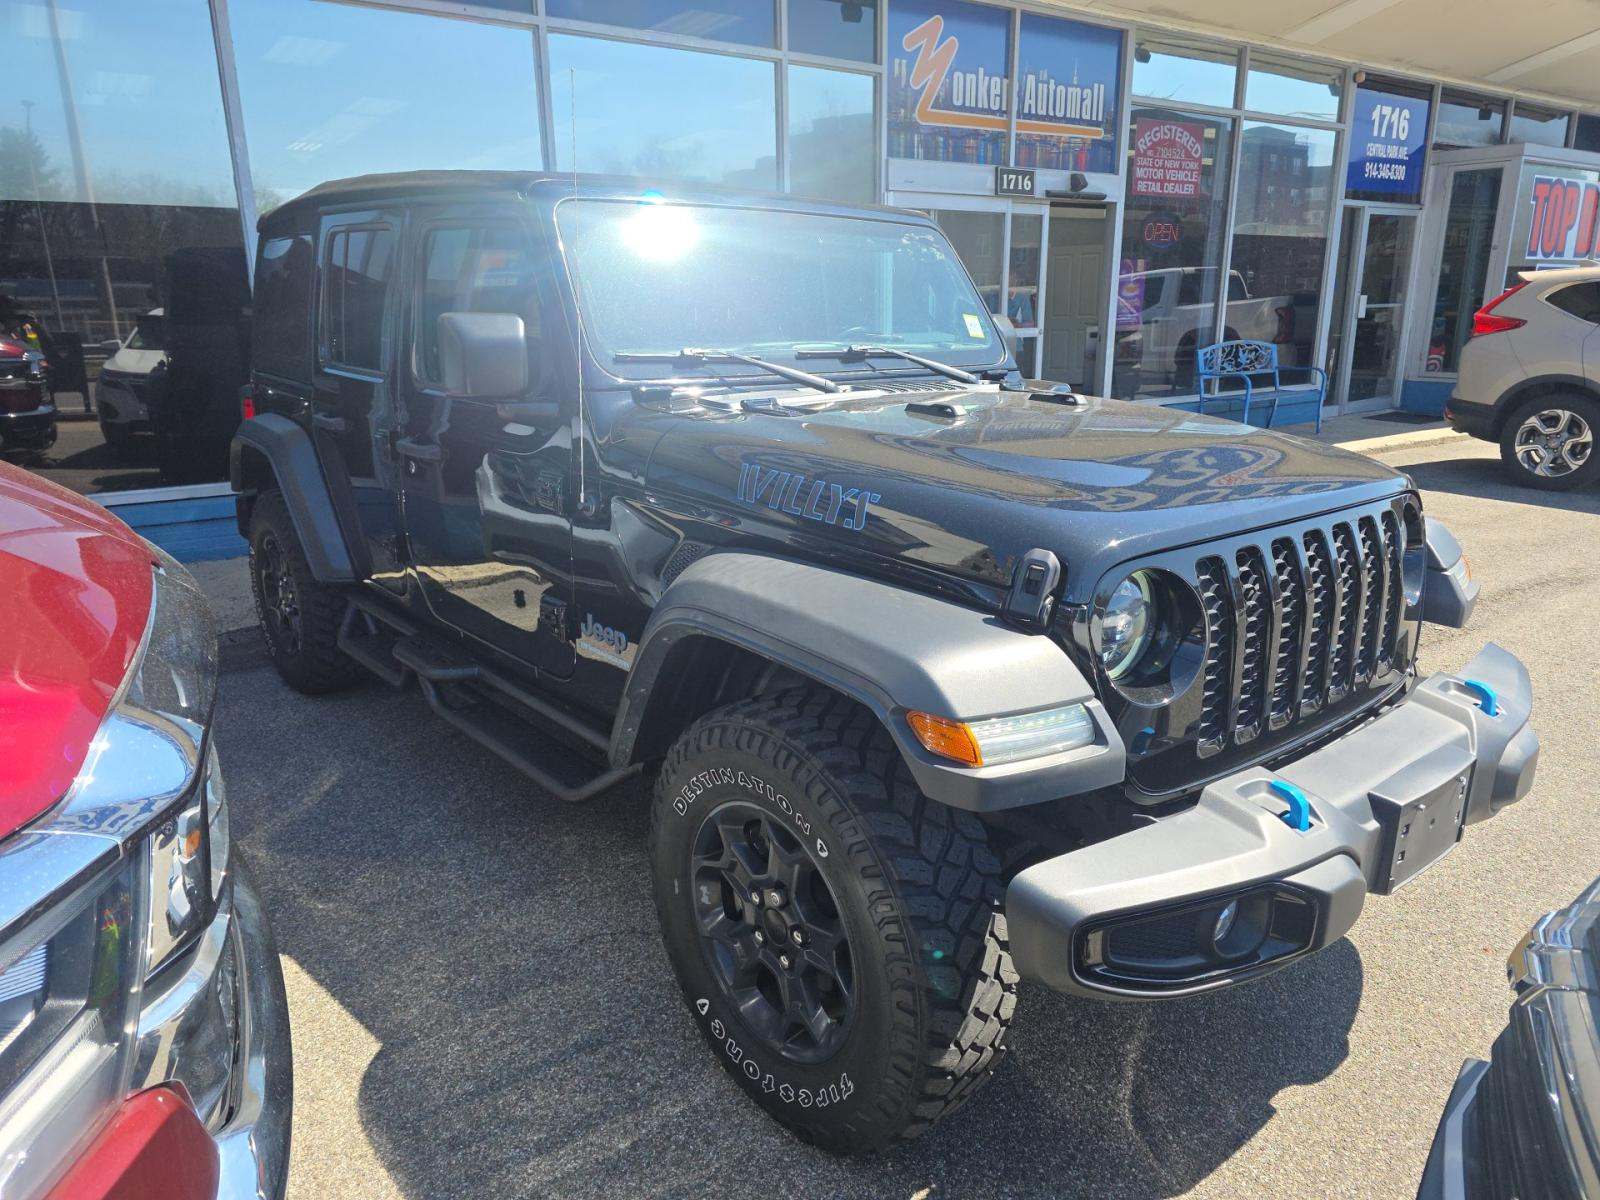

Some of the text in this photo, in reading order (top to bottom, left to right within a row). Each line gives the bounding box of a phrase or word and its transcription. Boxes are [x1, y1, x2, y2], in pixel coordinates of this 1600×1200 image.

[1023, 73, 1105, 122] Automall
[1371, 104, 1410, 141] 1716
[1137, 124, 1201, 158] REGISTERED
[1365, 143, 1387, 158] CENTRAL
[1387, 144, 1399, 159] PARK
[1136, 157, 1201, 170] STATE OF NEW YORK
[1136, 167, 1199, 182] MOTOR VEHICLE
[1002, 173, 1032, 191] 1716
[1136, 181, 1195, 195] RETAIL DEALER
[1144, 223, 1180, 241] OPEN
[1526, 176, 1580, 259] TOP
[737, 463, 882, 531] WILLYS
[580, 612, 628, 653] Jeep
[673, 767, 812, 836] DESTINATION
[711, 1019, 854, 1108] Firestone
